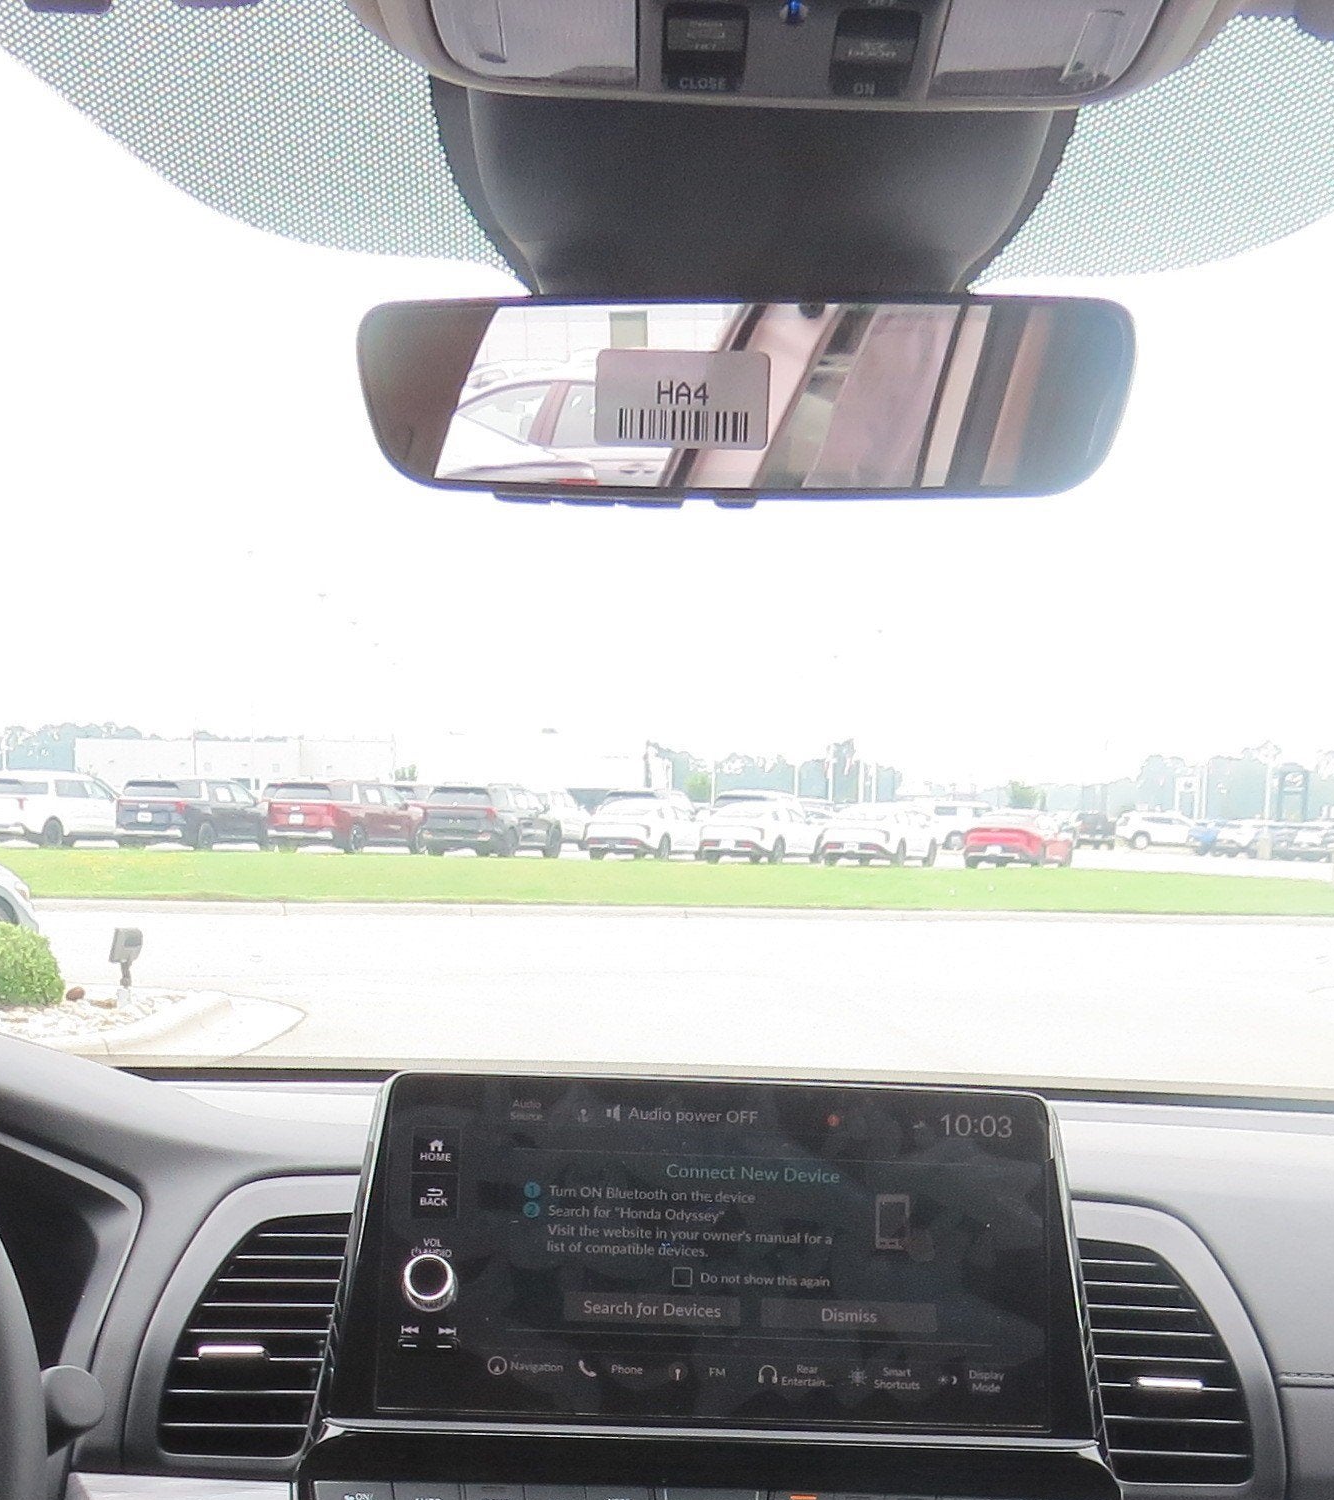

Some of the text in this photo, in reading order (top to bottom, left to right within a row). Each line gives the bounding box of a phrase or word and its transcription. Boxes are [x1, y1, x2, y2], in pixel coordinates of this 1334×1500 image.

[656, 380, 709, 406] HA4
[628, 1106, 759, 1125] Audio power OFF
[939, 1112, 1014, 1139] 10:03
[419, 1152, 452, 1163] HOME
[665, 1163, 841, 1184] Connect New Device
[419, 1197, 448, 1207] BACK
[548, 1184, 576, 1198] Turn
[579, 1185, 602, 1199] ON
[605, 1186, 667, 1201] Bluetooth
[671, 1191, 687, 1202] on
[690, 1189, 713, 1202] the
[714, 1190, 756, 1204] device
[548, 1204, 590, 1218] Search
[593, 1205, 610, 1218] for
[614, 1206, 661, 1220] "Honda
[664, 1208, 725, 1223] Odyssey"
[547, 1223, 833, 1245] Visit the website in your owner's manual for a
[423, 1238, 442, 1248] VOL
[546, 1240, 709, 1258] list of compatible devices.
[699, 1273, 831, 1290] Do not show this again
[583, 1300, 722, 1319] Search for Devices
[820, 1306, 878, 1325] Dismiss
[510, 1360, 564, 1375] Navigation
[610, 1363, 643, 1376] Phone
[708, 1366, 726, 1378] FM
[796, 1363, 818, 1375] Rear
[882, 1366, 912, 1378] Smart
[874, 1378, 921, 1391] Shortcuts
[968, 1369, 1005, 1384] Display
[971, 1382, 1002, 1394] Mode
